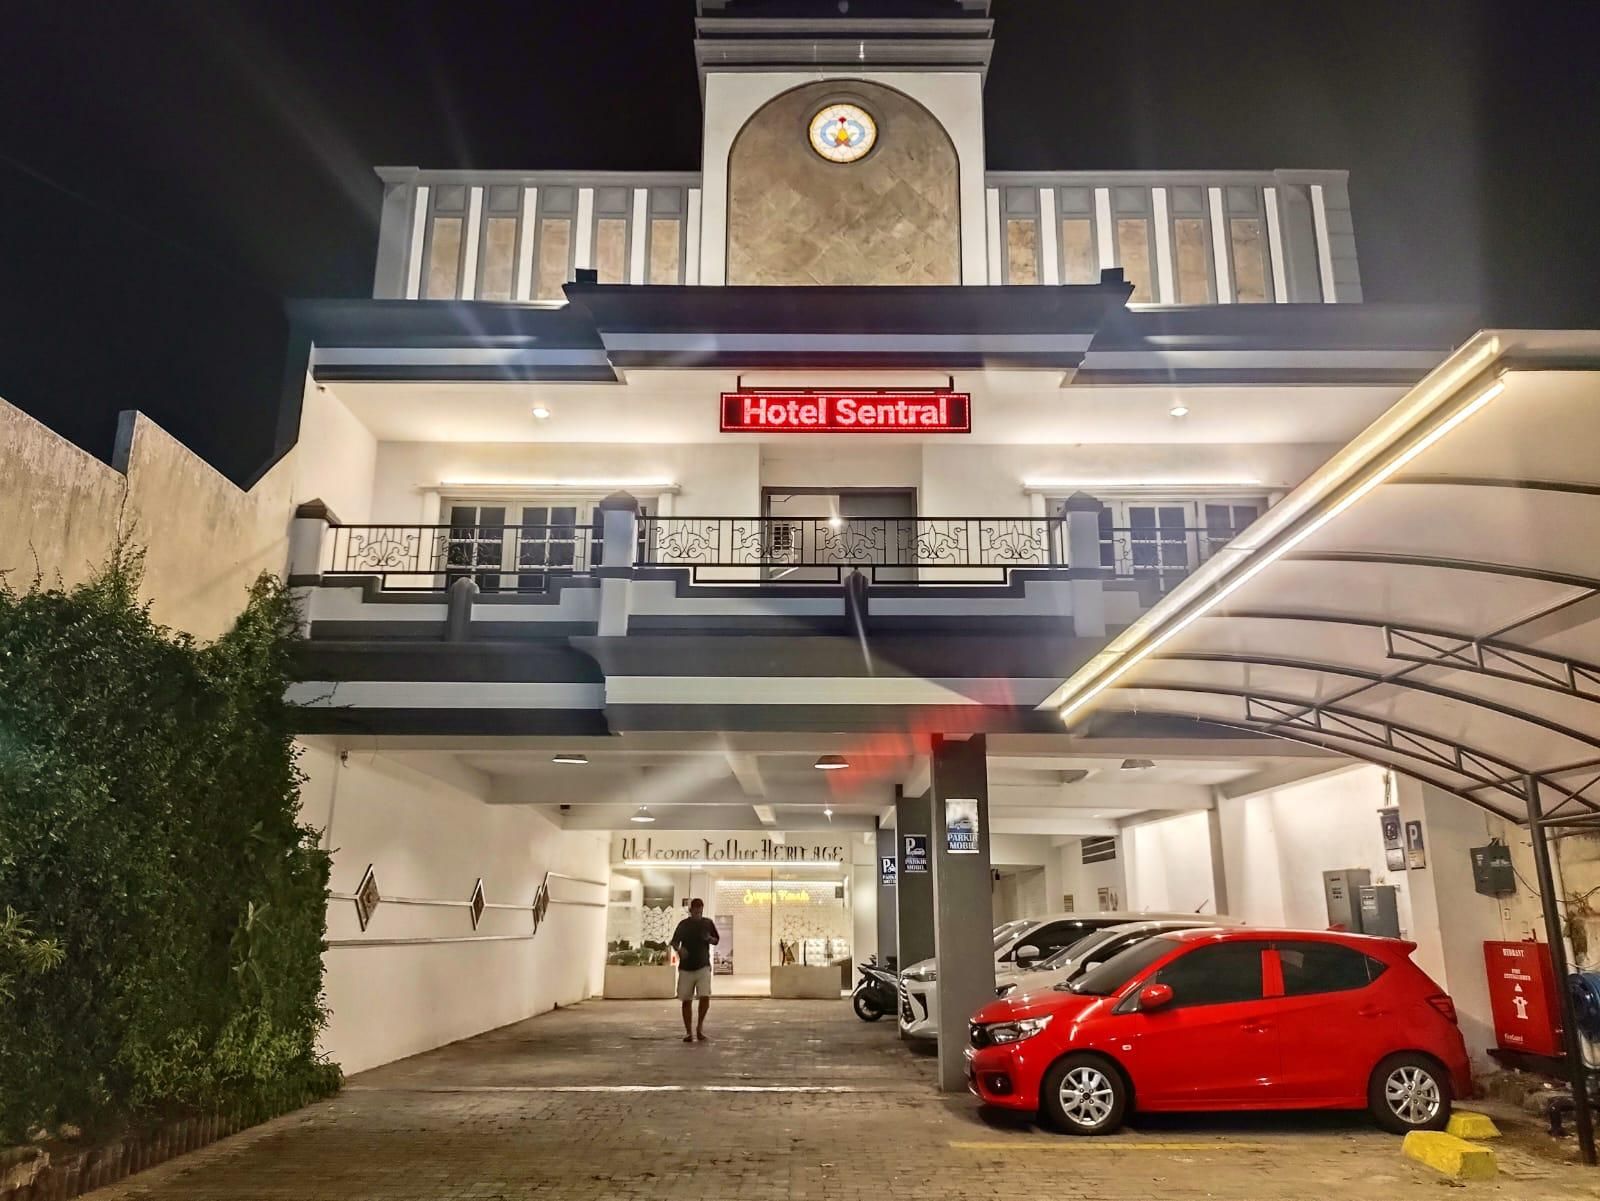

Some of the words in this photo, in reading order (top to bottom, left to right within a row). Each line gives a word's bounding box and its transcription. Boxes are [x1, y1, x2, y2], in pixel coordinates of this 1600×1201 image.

[743, 398, 827, 425] Hotel
[836, 398, 947, 425] Sentral
[947, 833, 979, 841] PARKIR
[949, 841, 977, 850] MOBIL
[1409, 824, 1418, 849] P
[622, 837, 701, 861] Welcome
[702, 838, 725, 861] To
[726, 838, 758, 861] Our
[905, 837, 916, 856] P
[882, 858, 891, 874] P
